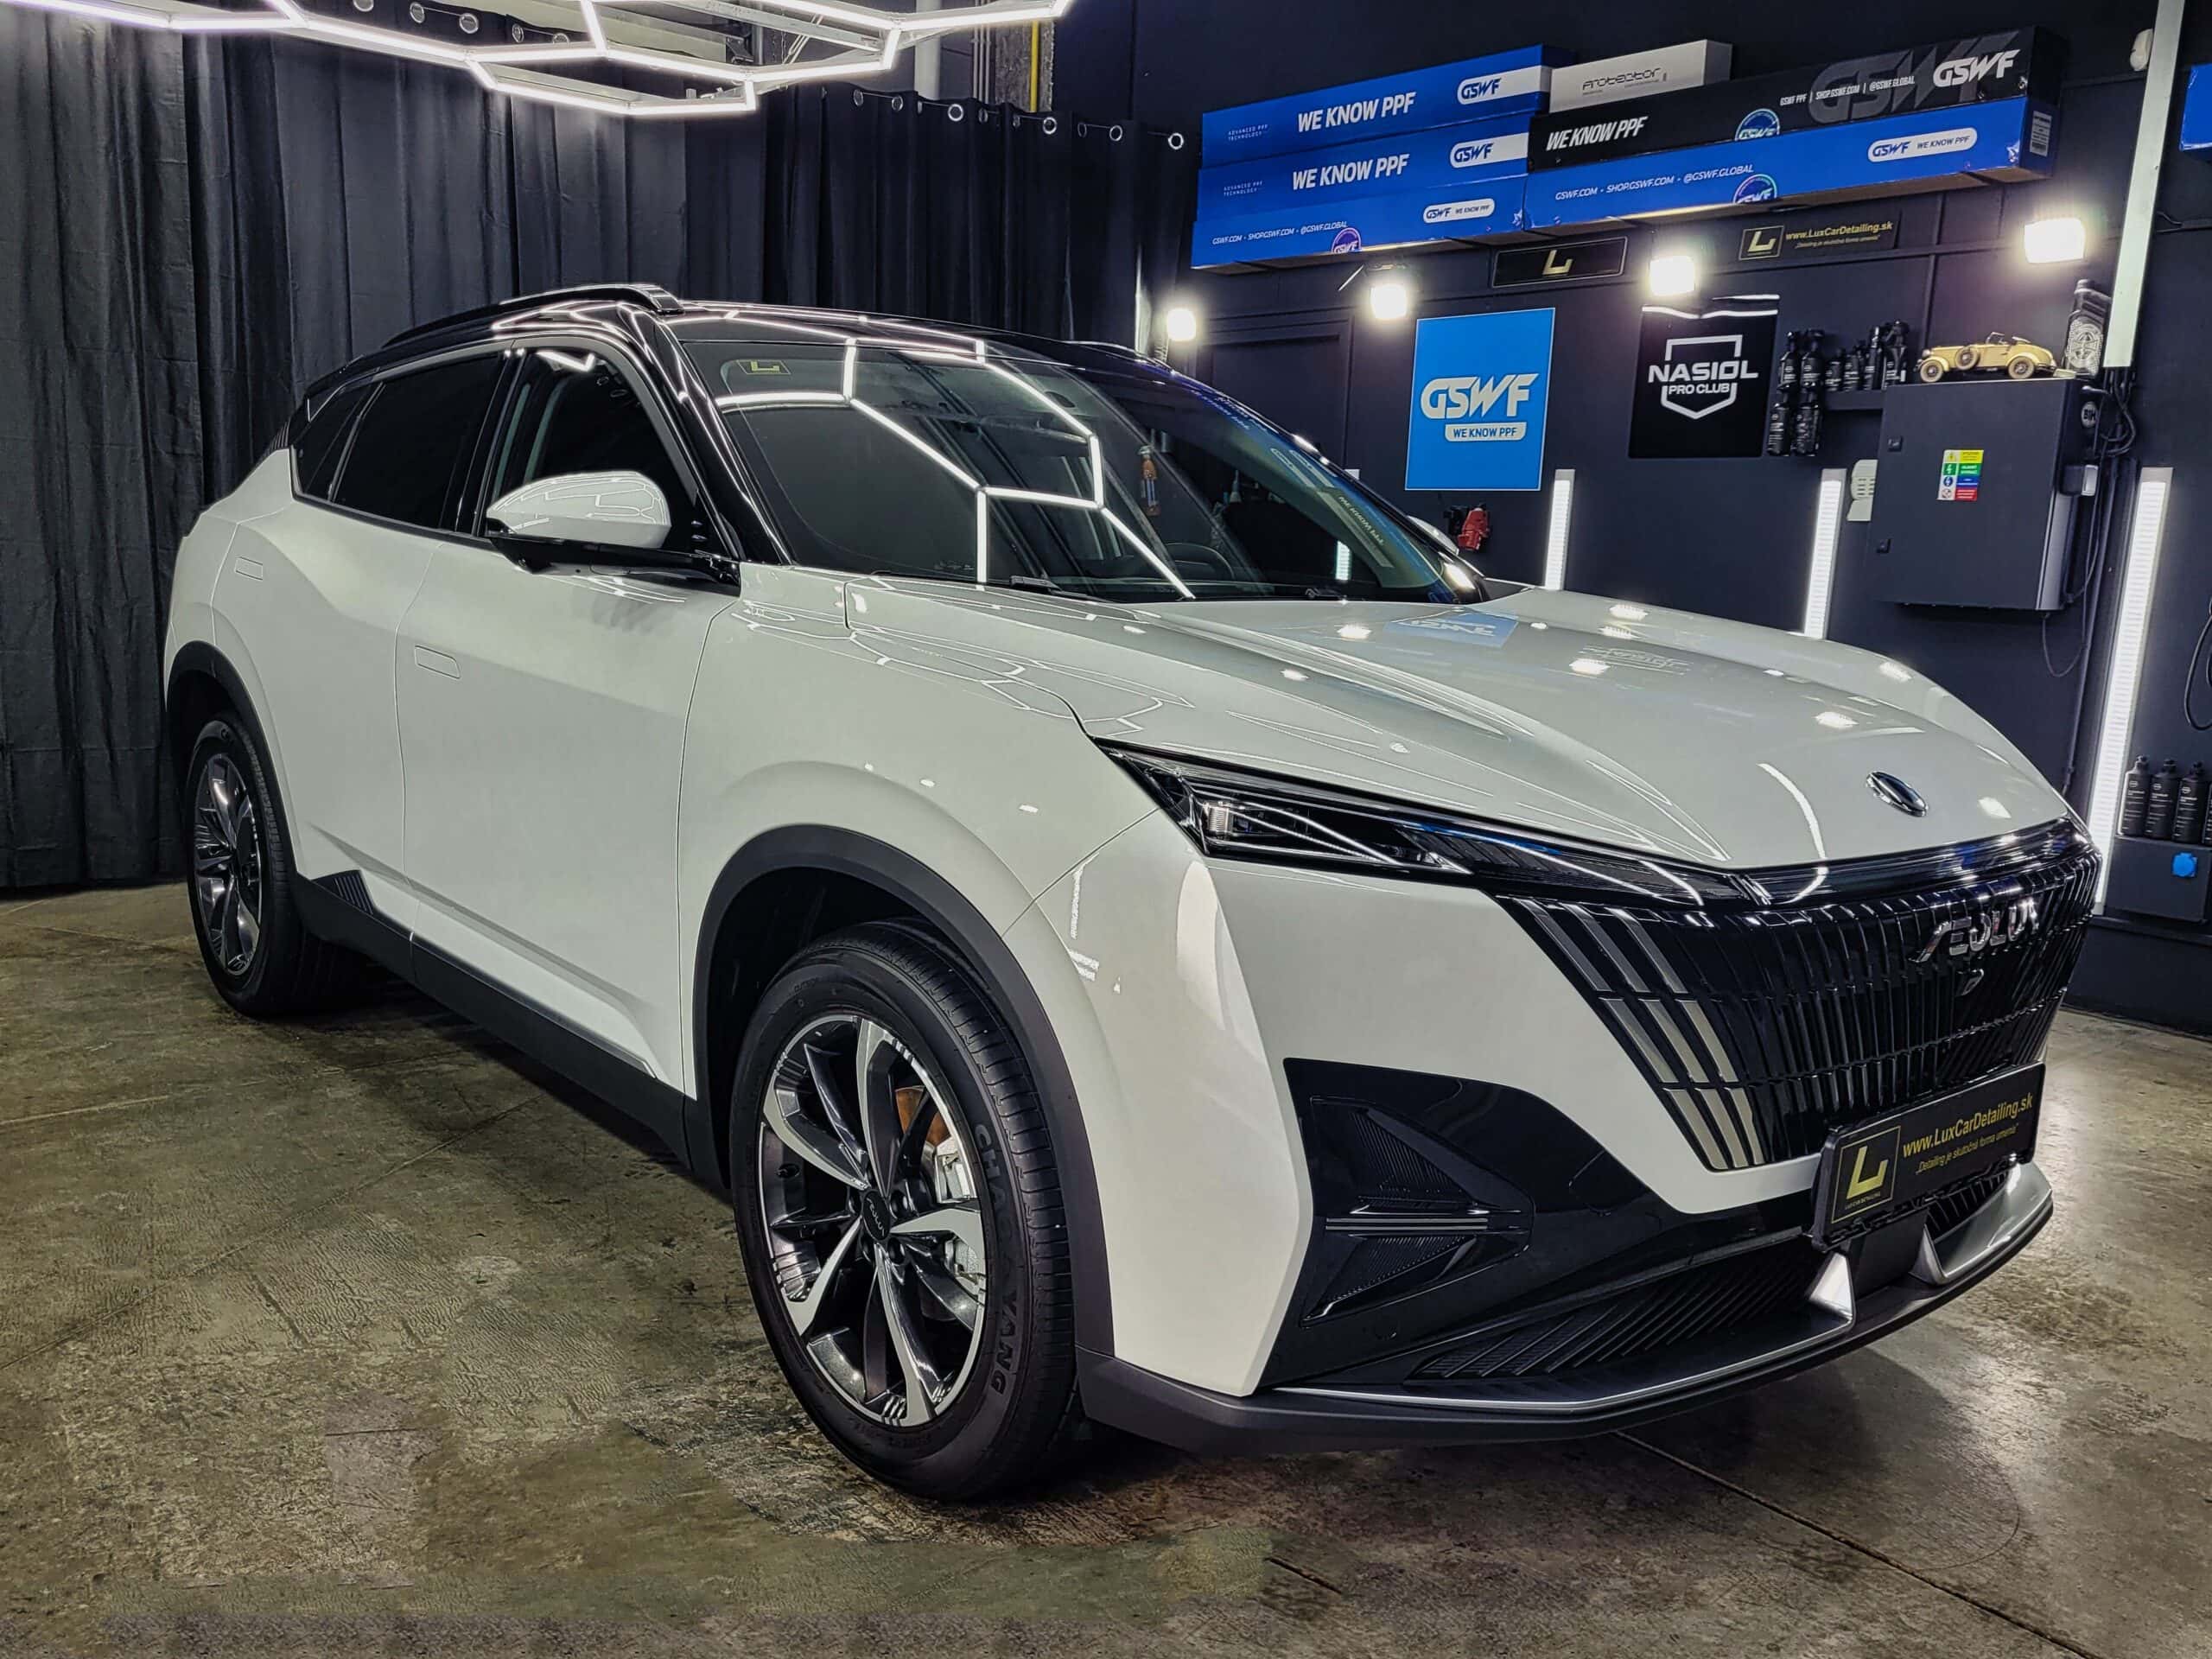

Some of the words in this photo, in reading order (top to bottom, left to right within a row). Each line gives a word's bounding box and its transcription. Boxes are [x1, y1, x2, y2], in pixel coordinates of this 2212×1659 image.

[1934, 49, 2020, 87] GSWF
[1461, 78, 1502, 99] GSWF
[1298, 110, 1323, 132] WE
[1325, 99, 1380, 128] KNOW
[1382, 92, 1417, 118] PPF
[1546, 130, 1572, 151] WE
[1569, 121, 1618, 147] KNOW
[1614, 116, 1649, 139] PPF
[1454, 143, 1493, 162] GSWF
[1872, 141, 1911, 157] GSWF
[1930, 137, 1955, 148] KNOW
[1955, 136, 1970, 144] PPF
[1293, 168, 1317, 190] WE
[1319, 159, 1373, 186] KNOW
[1375, 154, 1410, 178] PPF
[1555, 186, 1598, 200] GSWF.COM
[1606, 175, 1674, 194] SHOP.GSWF.COM
[1683, 164, 1753, 184] @GSWF.GLOBAL
[1426, 207, 1452, 219] GSWF
[1786, 220, 1893, 240] www.LuxCarDetailing.sk
[1648, 359, 1758, 383] NASIOL
[1421, 373, 1539, 419] GSWF
[1669, 385, 1694, 395] PRO
[1696, 383, 1730, 394] CLUB
[1453, 428, 1466, 438] WE
[1469, 428, 1497, 438] KNOW
[1499, 427, 1517, 437] PPF
[1903, 1091, 2033, 1158] www.LuxCarDetailing.sk
